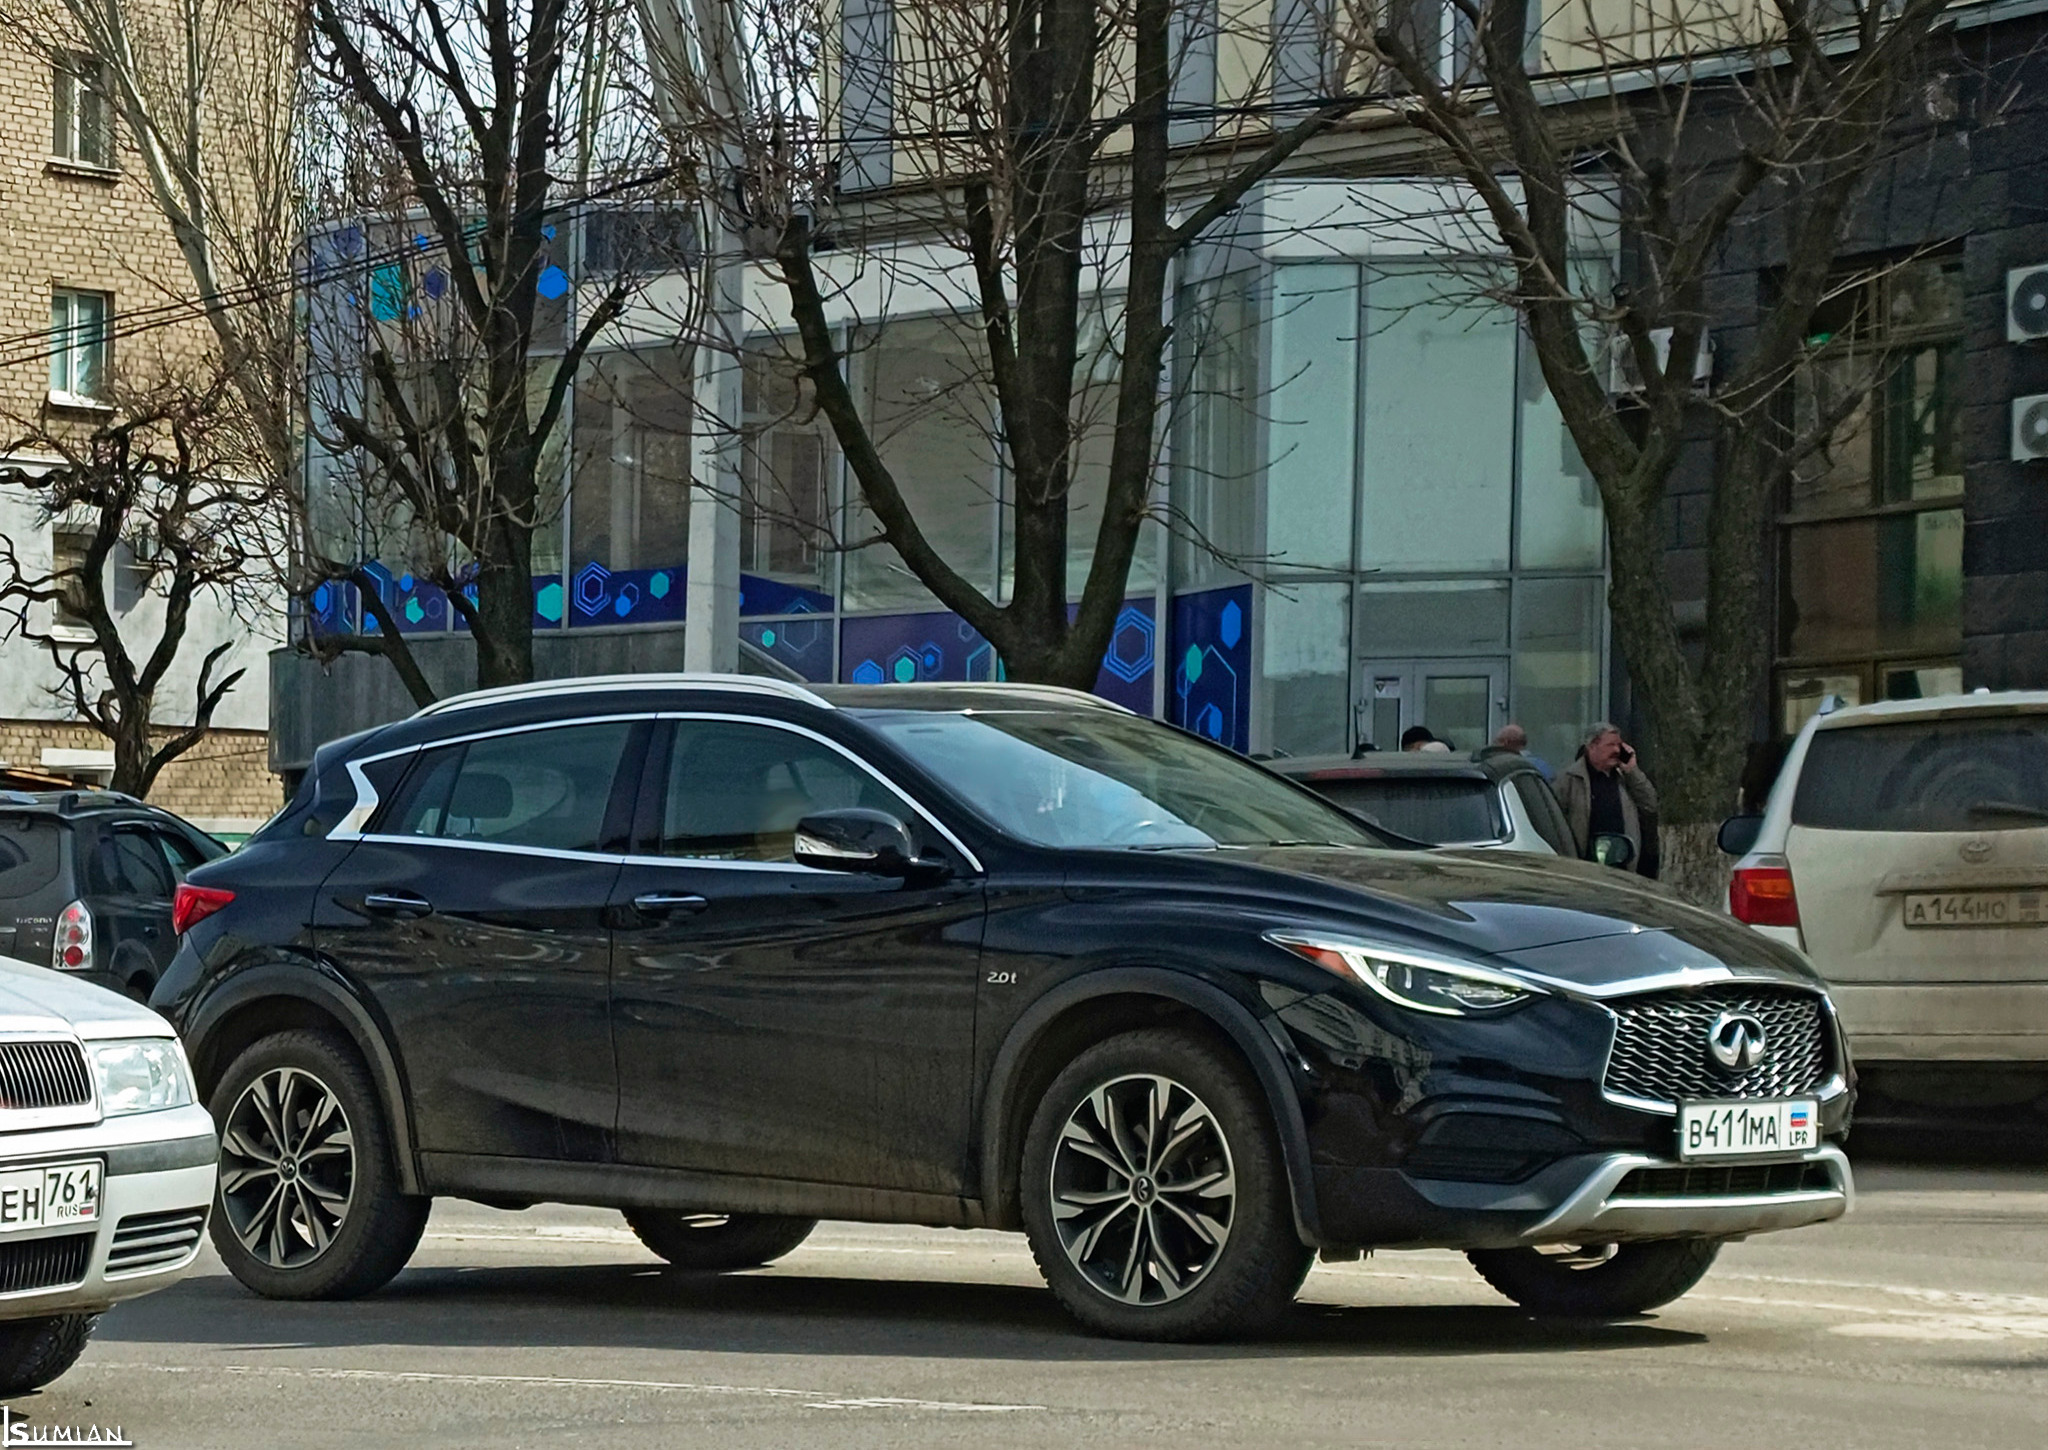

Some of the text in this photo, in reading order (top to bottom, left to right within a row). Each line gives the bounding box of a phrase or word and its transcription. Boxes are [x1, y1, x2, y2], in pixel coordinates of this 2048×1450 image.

[1689, 1107, 1778, 1149] В411МА
[1789, 1130, 1808, 1147] LPR
[47, 1168, 92, 1207] 761
[56, 1203, 79, 1219] RUS
